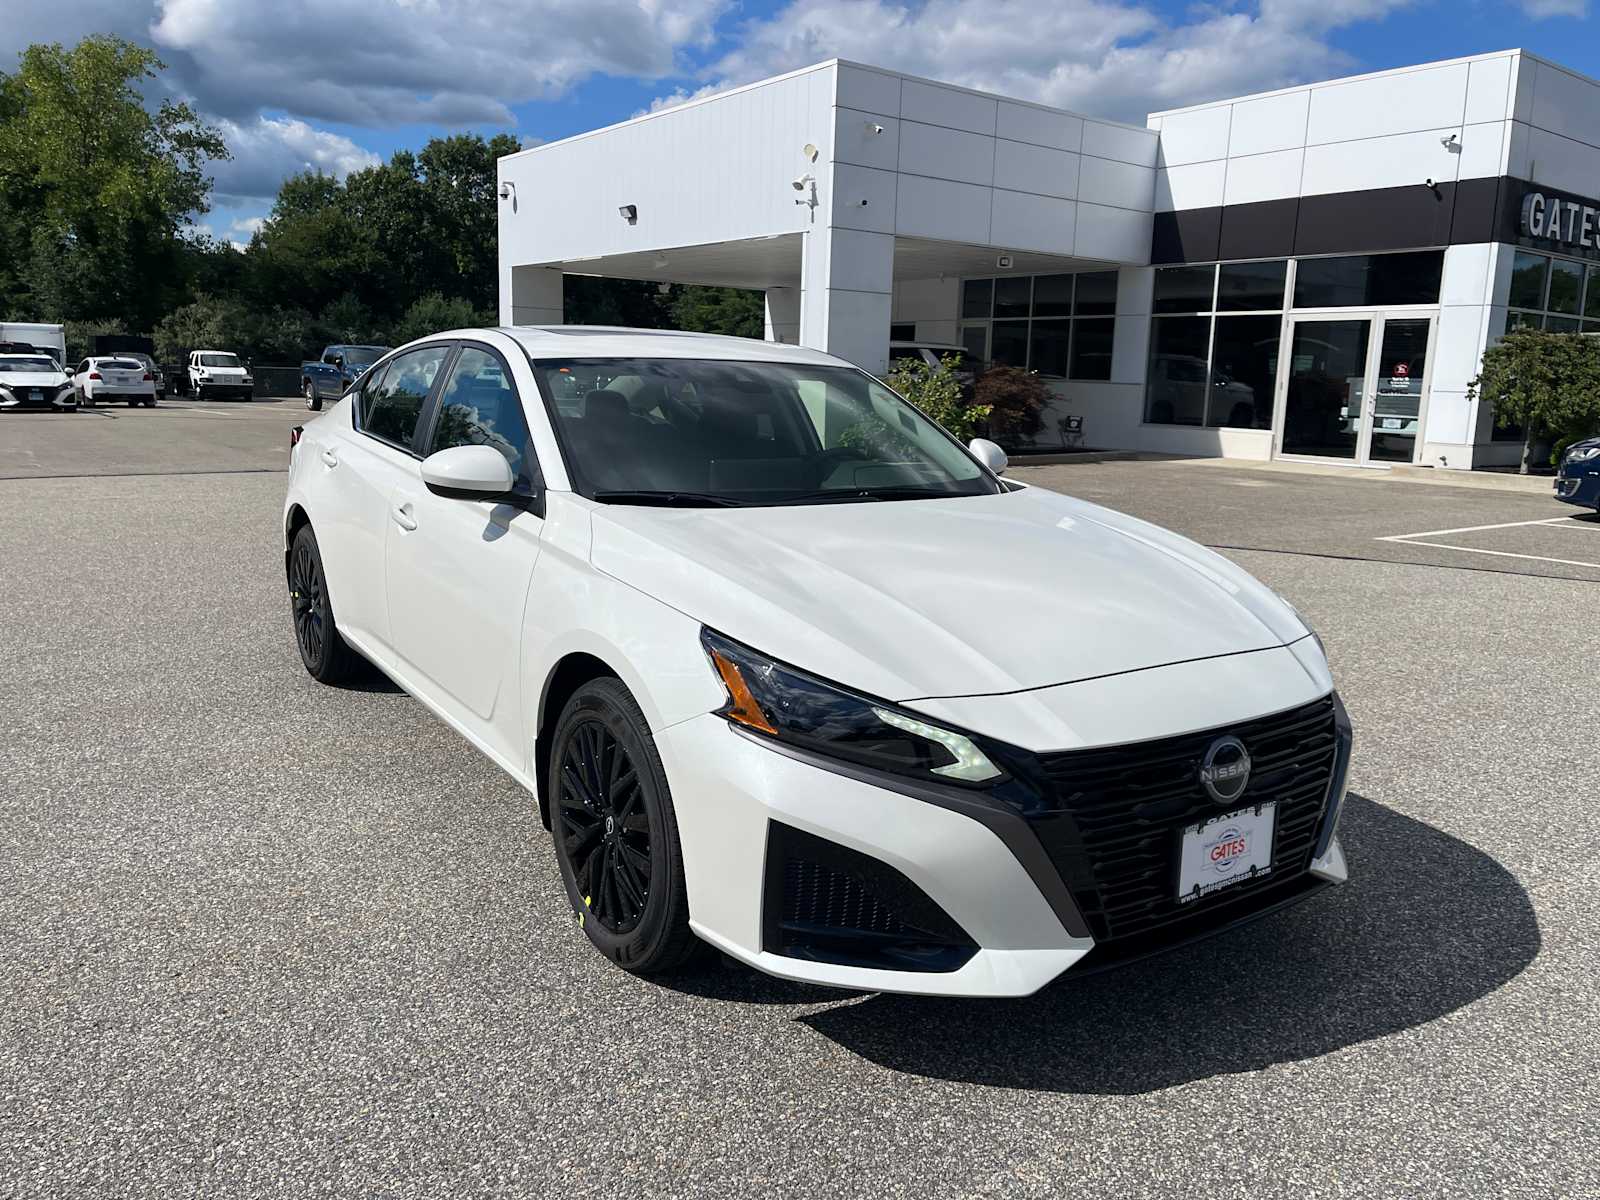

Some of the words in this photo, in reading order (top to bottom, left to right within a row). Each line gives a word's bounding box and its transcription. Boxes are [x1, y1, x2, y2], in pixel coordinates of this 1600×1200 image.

[1525, 192, 1600, 250] GATE
[1201, 757, 1250, 781] NISSAN
[1211, 838, 1245, 861] GATES
